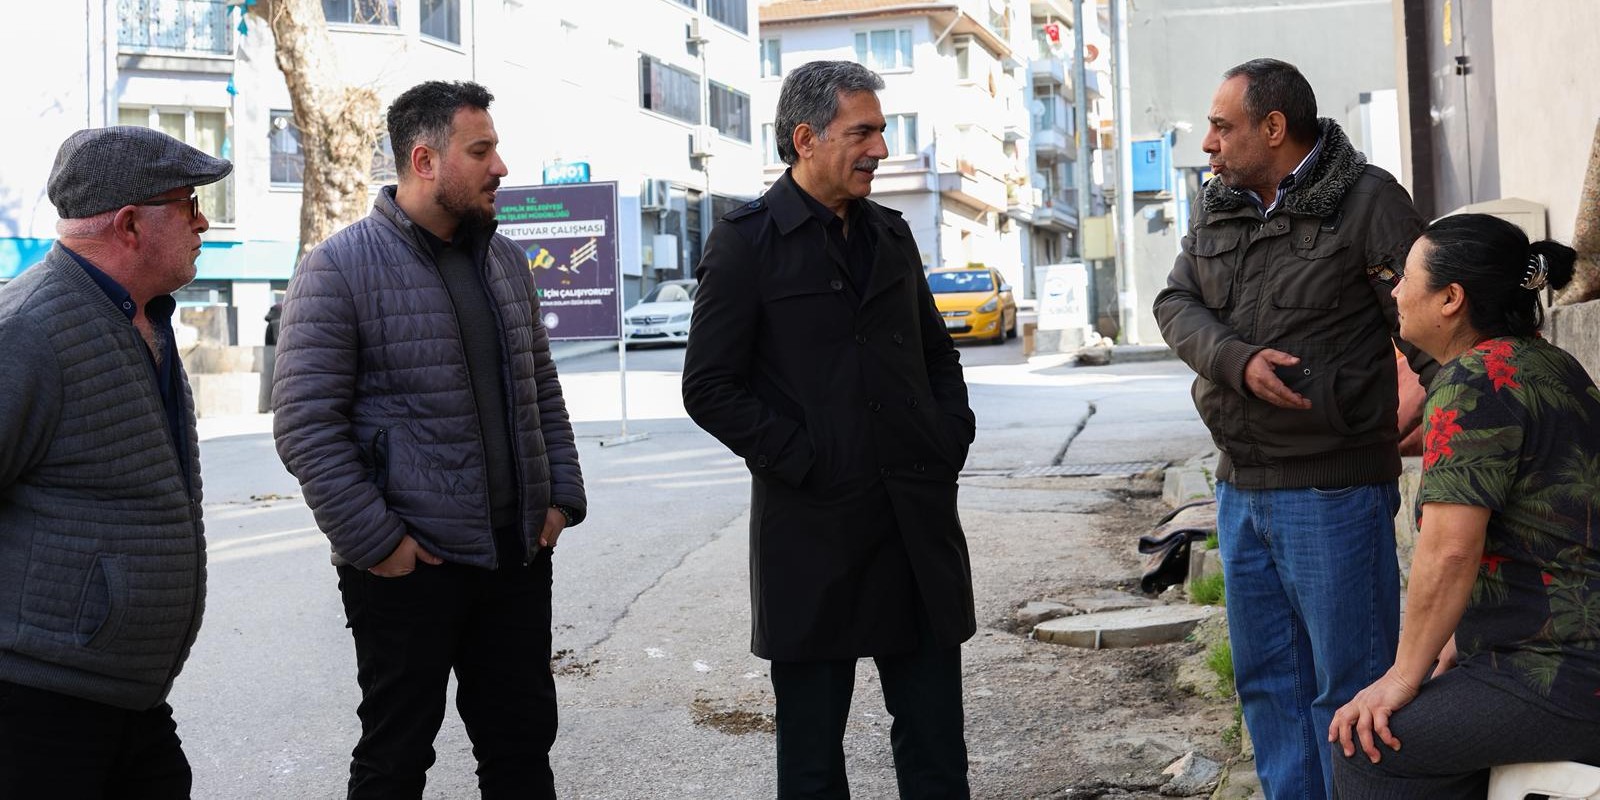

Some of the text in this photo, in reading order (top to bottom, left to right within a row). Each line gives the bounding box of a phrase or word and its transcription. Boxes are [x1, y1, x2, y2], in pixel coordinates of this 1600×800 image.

[526, 203, 563, 212] BELEDİYESİ
[499, 224, 603, 236] TRETUVAR ÇALIŞMASI
[543, 288, 559, 299] İÇİN
